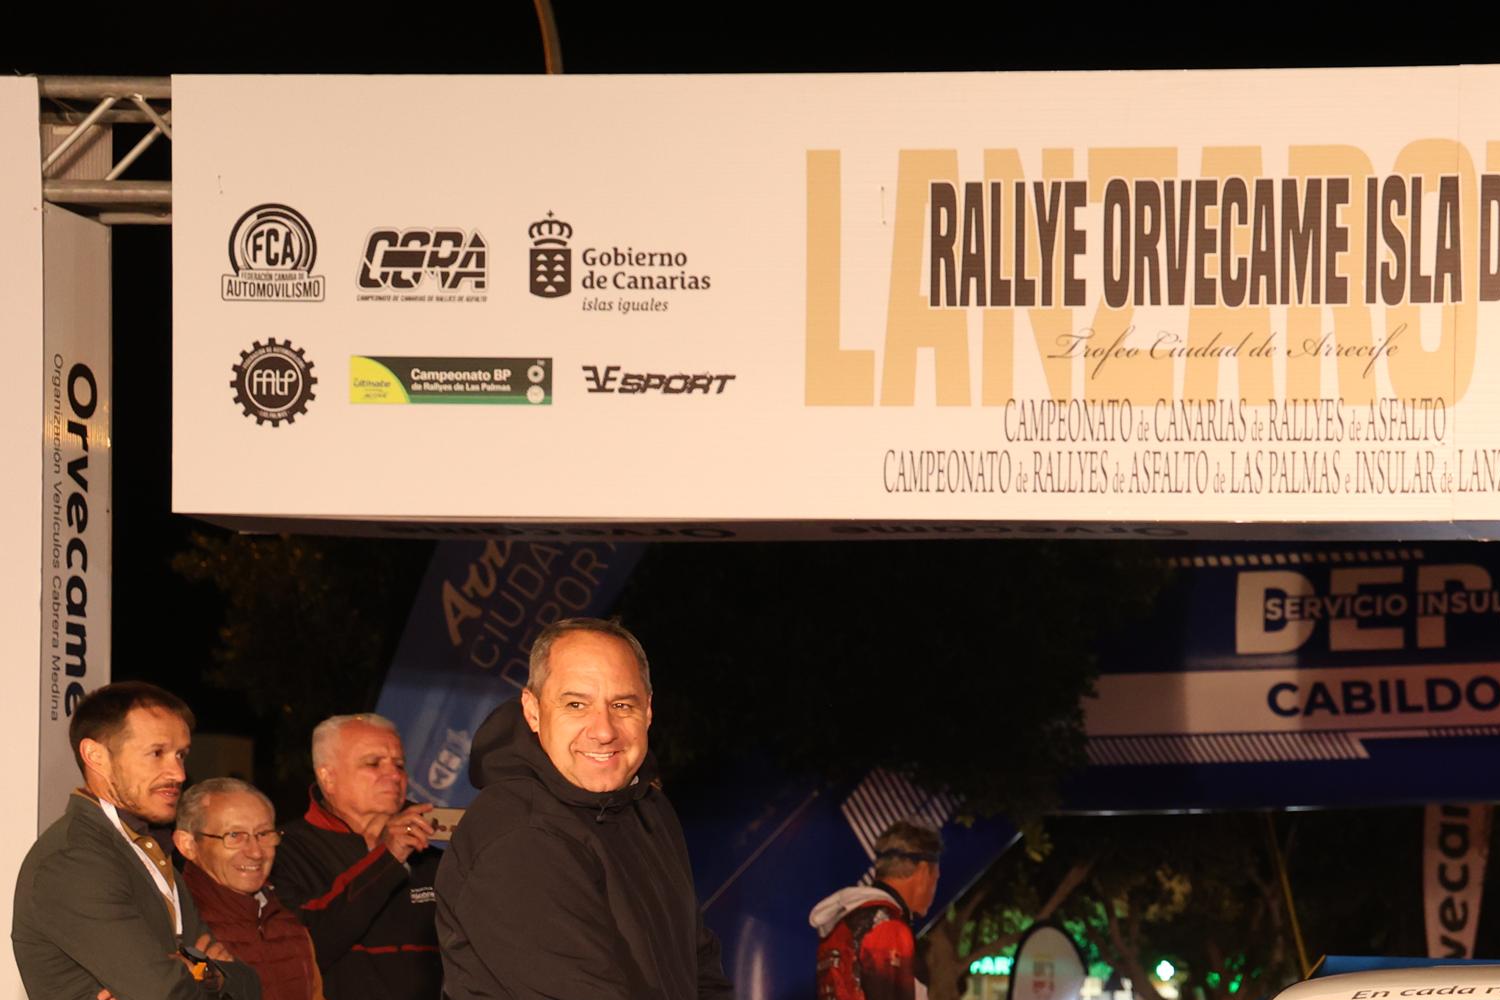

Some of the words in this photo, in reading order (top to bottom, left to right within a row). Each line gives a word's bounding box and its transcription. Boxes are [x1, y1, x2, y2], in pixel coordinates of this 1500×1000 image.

[251, 228, 295, 266] FCA
[581, 247, 688, 267] Gobierno
[930, 181, 1087, 307] RALLYE
[1102, 177, 1350, 308] ORVECAME
[1364, 175, 1463, 306] ISLA
[226, 279, 320, 298] AUTOMOVILISMO
[581, 271, 608, 290] de
[612, 271, 712, 290] Canarias
[581, 297, 614, 312] islas
[617, 297, 669, 315] iguales
[1046, 325, 1139, 381] Trofeo
[1149, 329, 1253, 361] Ciudad
[1248, 331, 1278, 360] de
[1286, 322, 1409, 380] Arrecife
[410, 368, 492, 382] Campeonato
[493, 368, 512, 381] BP
[50, 352, 64, 474] Organización
[1003, 397, 1134, 443] CAMPEONATO
[1136, 410, 1150, 442] de
[1154, 397, 1248, 443] CANARIAS
[1250, 408, 1264, 442] de
[1267, 397, 1345, 442] RALLYES
[1348, 408, 1361, 442] de
[1364, 396, 1446, 443] ASFALTO
[883, 449, 1012, 494] CAMPEONATO
[1015, 460, 1028, 493] de
[1031, 450, 1109, 494] RALLYES
[1112, 461, 1126, 493] de
[1128, 450, 1209, 494] ASFALTO
[1212, 461, 1226, 494] de
[1230, 450, 1264, 494] LAS
[1268, 450, 1341, 494] PALMAS
[1344, 473, 1351, 494] e
[1355, 450, 1437, 494] INSULAR
[1439, 460, 1454, 494] de
[51, 481, 64, 570] Vehículos
[63, 361, 98, 718] Orvecame
[51, 574, 63, 650] Cabrera
[1264, 593, 1409, 621] SERVICIO
[50, 654, 62, 722] Medina
[1351, 989, 1391, 1000] En
[1399, 984, 1476, 998] cada
